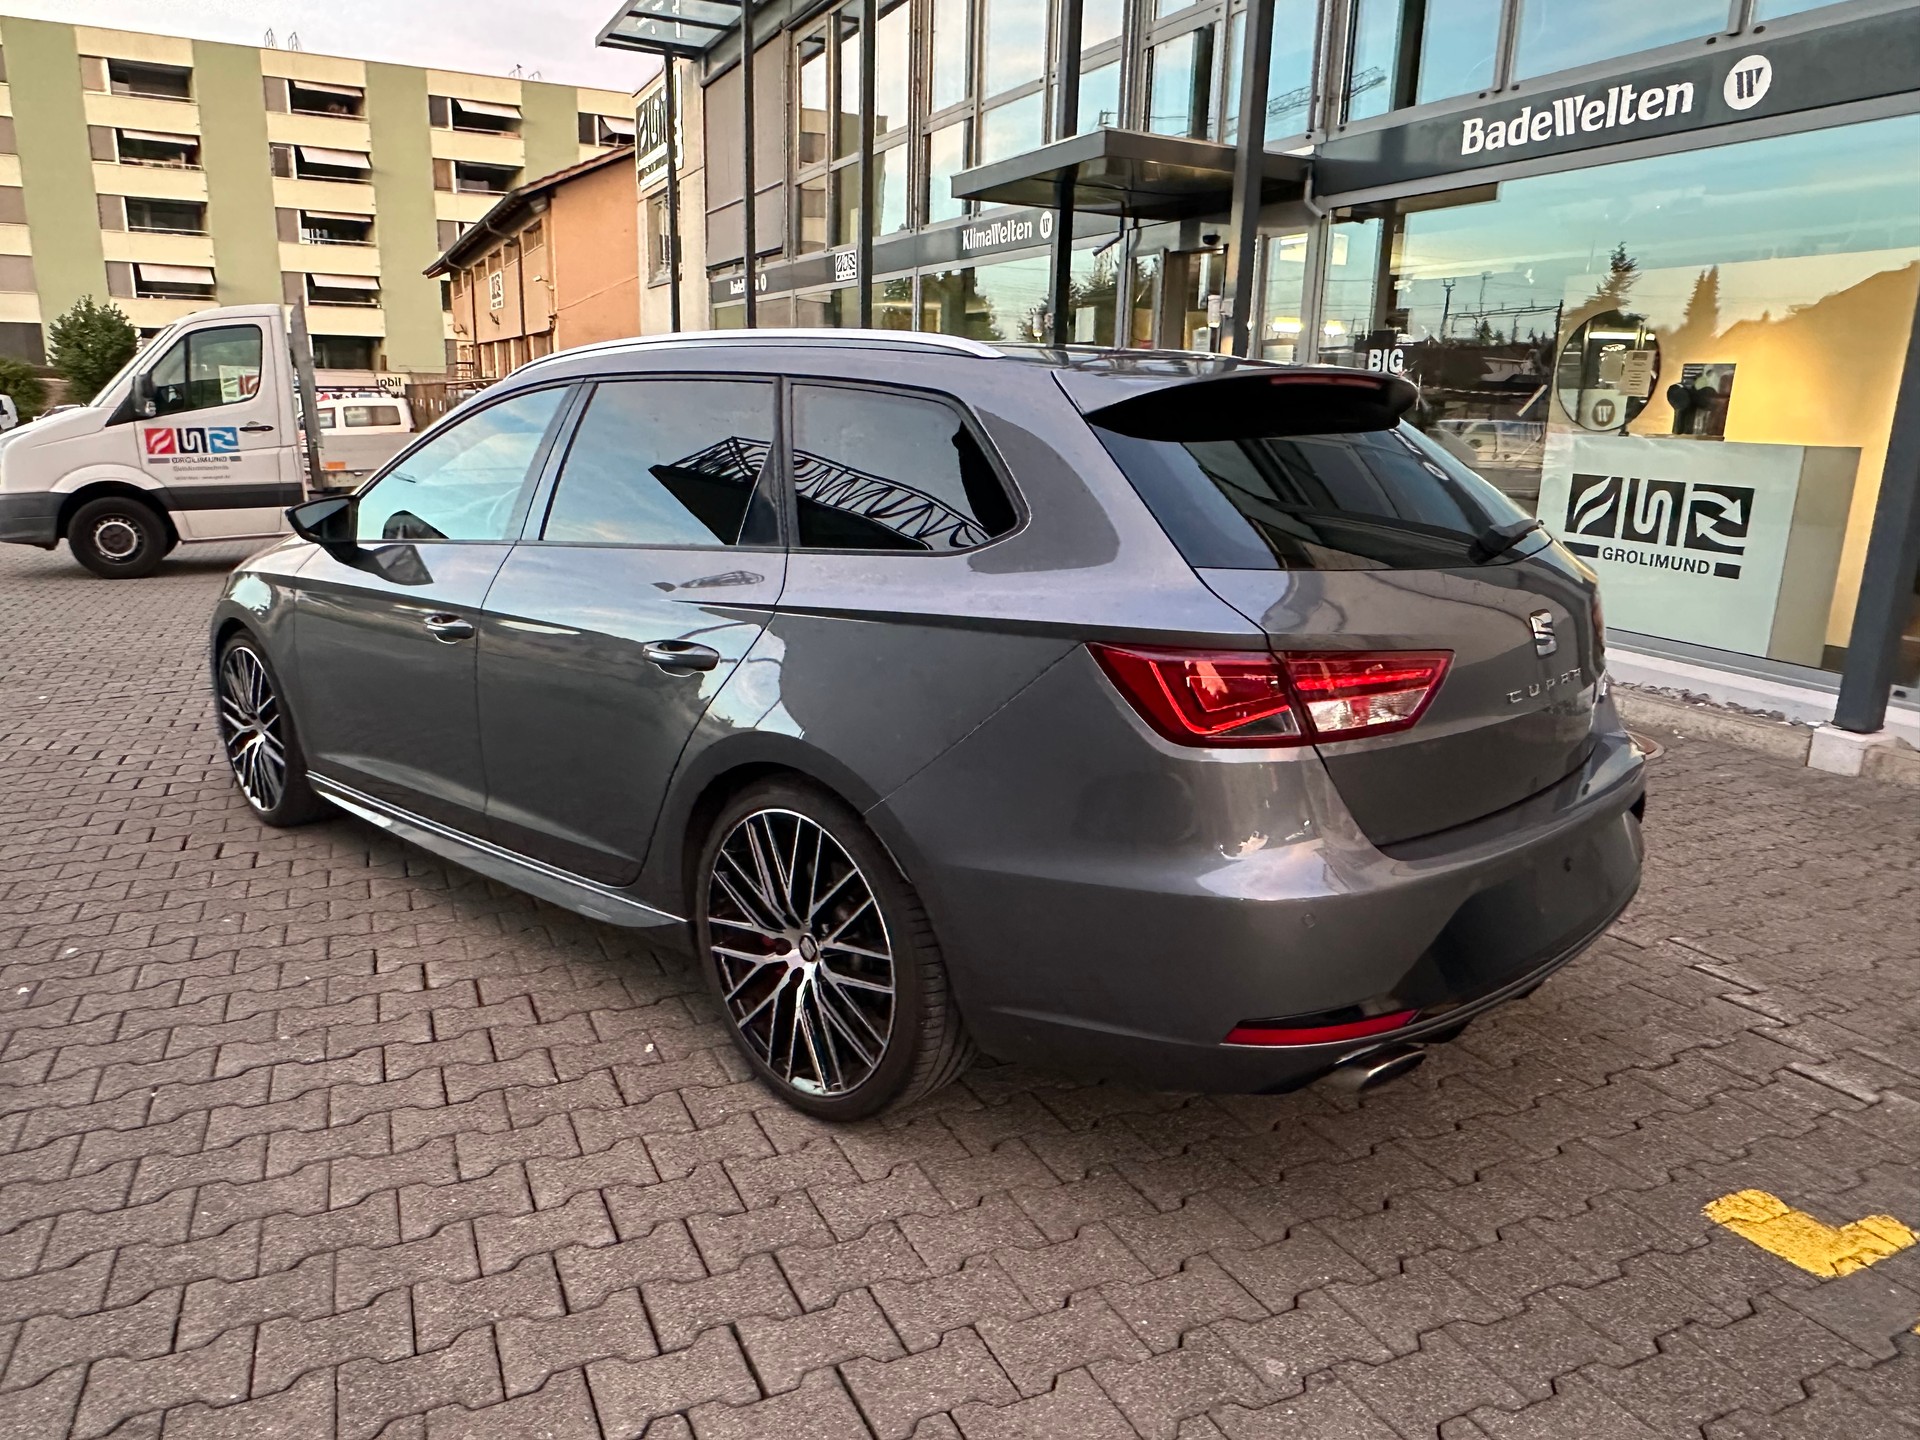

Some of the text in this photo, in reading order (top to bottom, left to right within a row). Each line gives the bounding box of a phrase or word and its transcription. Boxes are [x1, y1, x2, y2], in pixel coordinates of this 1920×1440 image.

[1461, 82, 1694, 155] BadeWelten
[963, 220, 1032, 250] KlimaWelten
[1368, 349, 1404, 374] BIG
[1602, 547, 1710, 575] GROLIMUND
